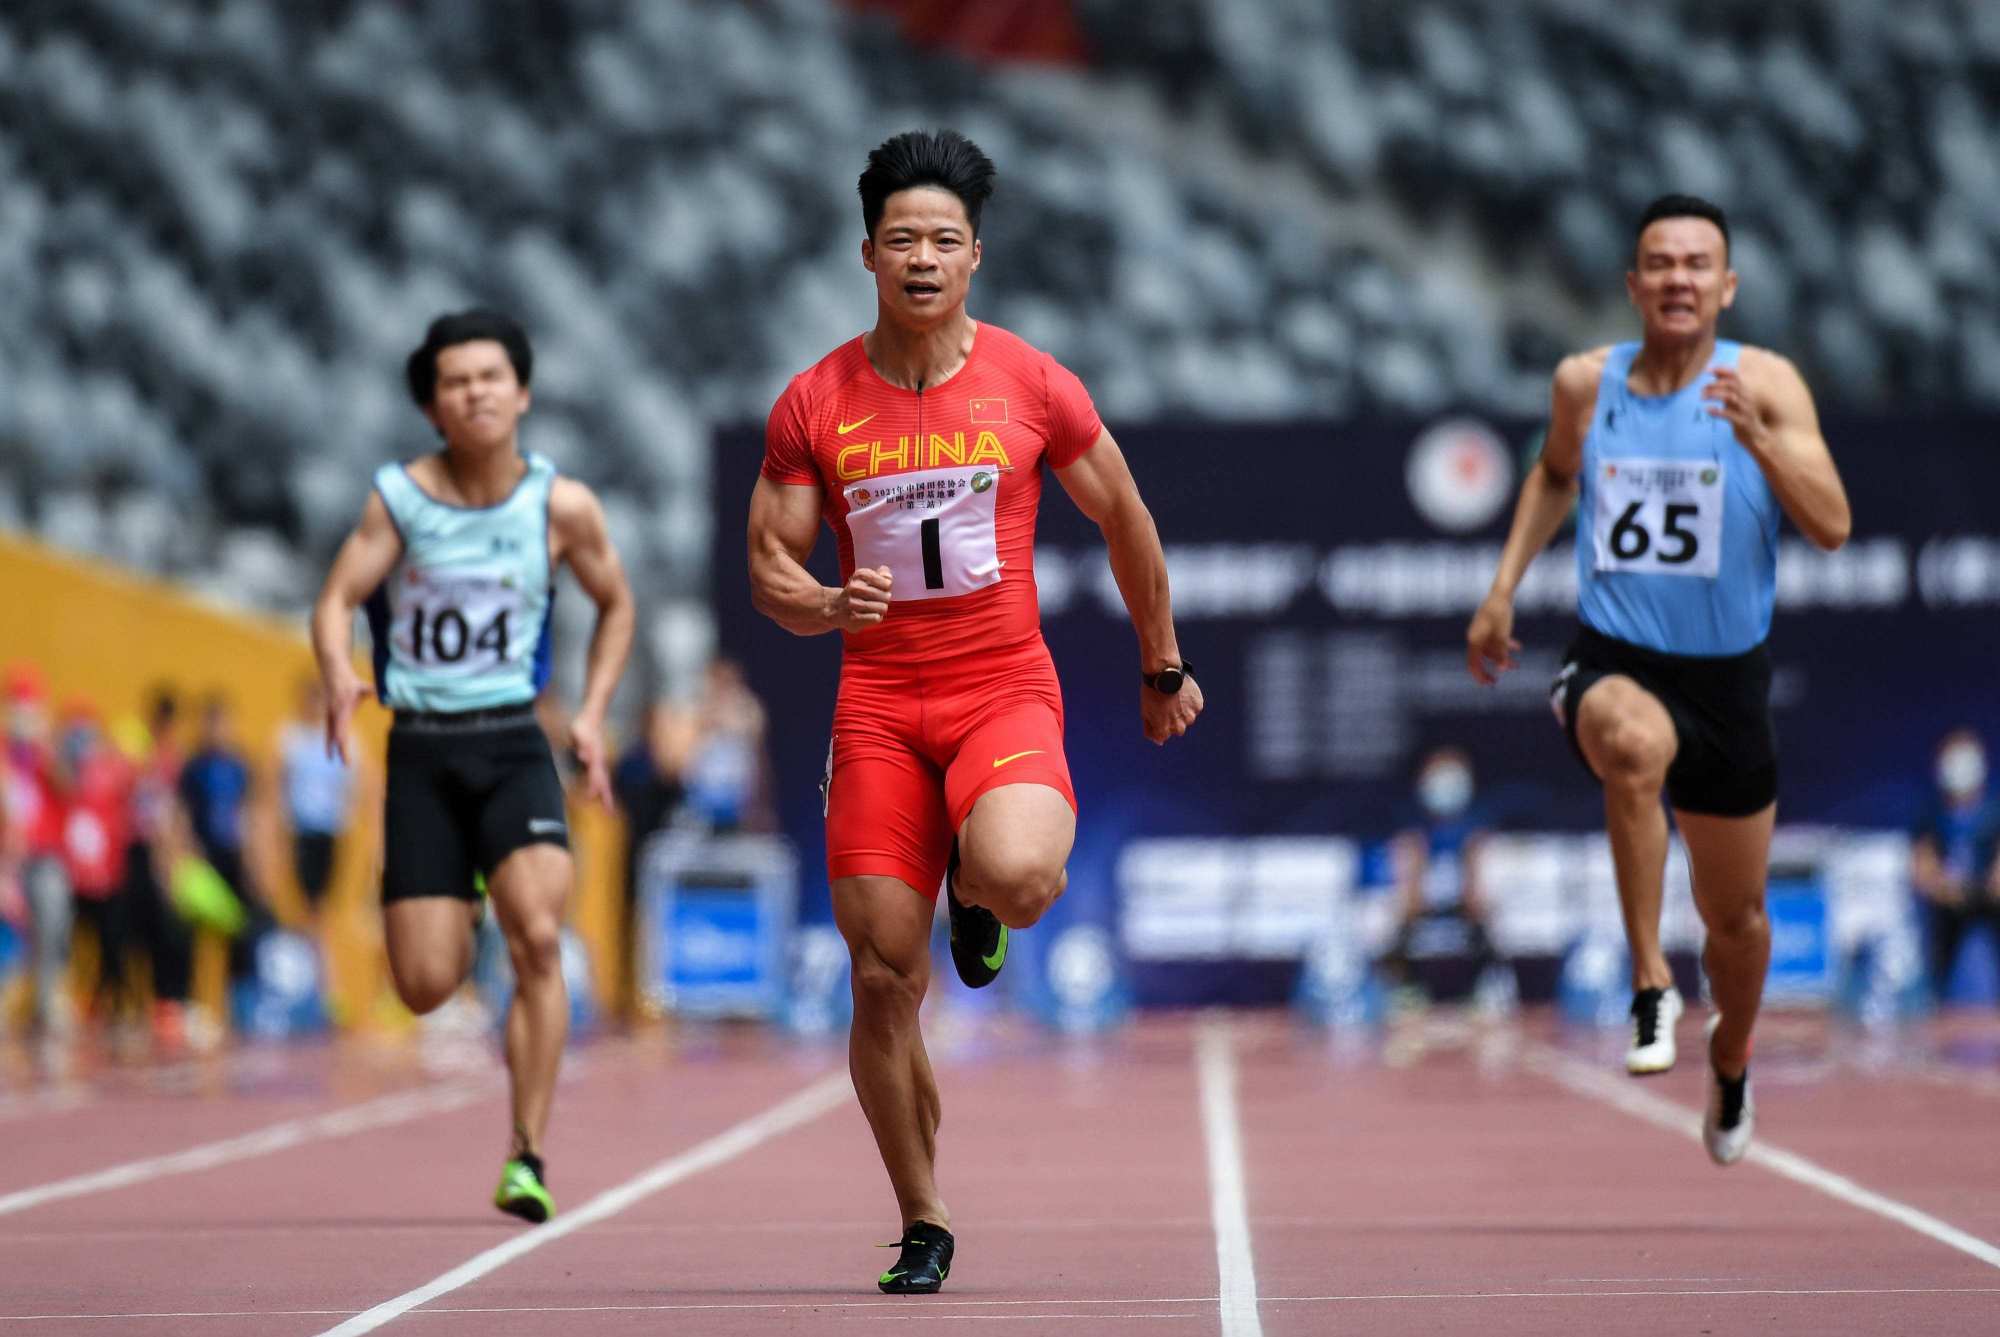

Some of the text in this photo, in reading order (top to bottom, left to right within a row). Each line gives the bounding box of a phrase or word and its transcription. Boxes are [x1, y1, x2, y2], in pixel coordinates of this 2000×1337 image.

[836, 431, 1010, 481] CHINA
[875, 479, 966, 497] 2021年中国田径协会
[921, 518, 944, 590] 1
[1610, 501, 1699, 564] 65
[412, 605, 509, 664] 104
